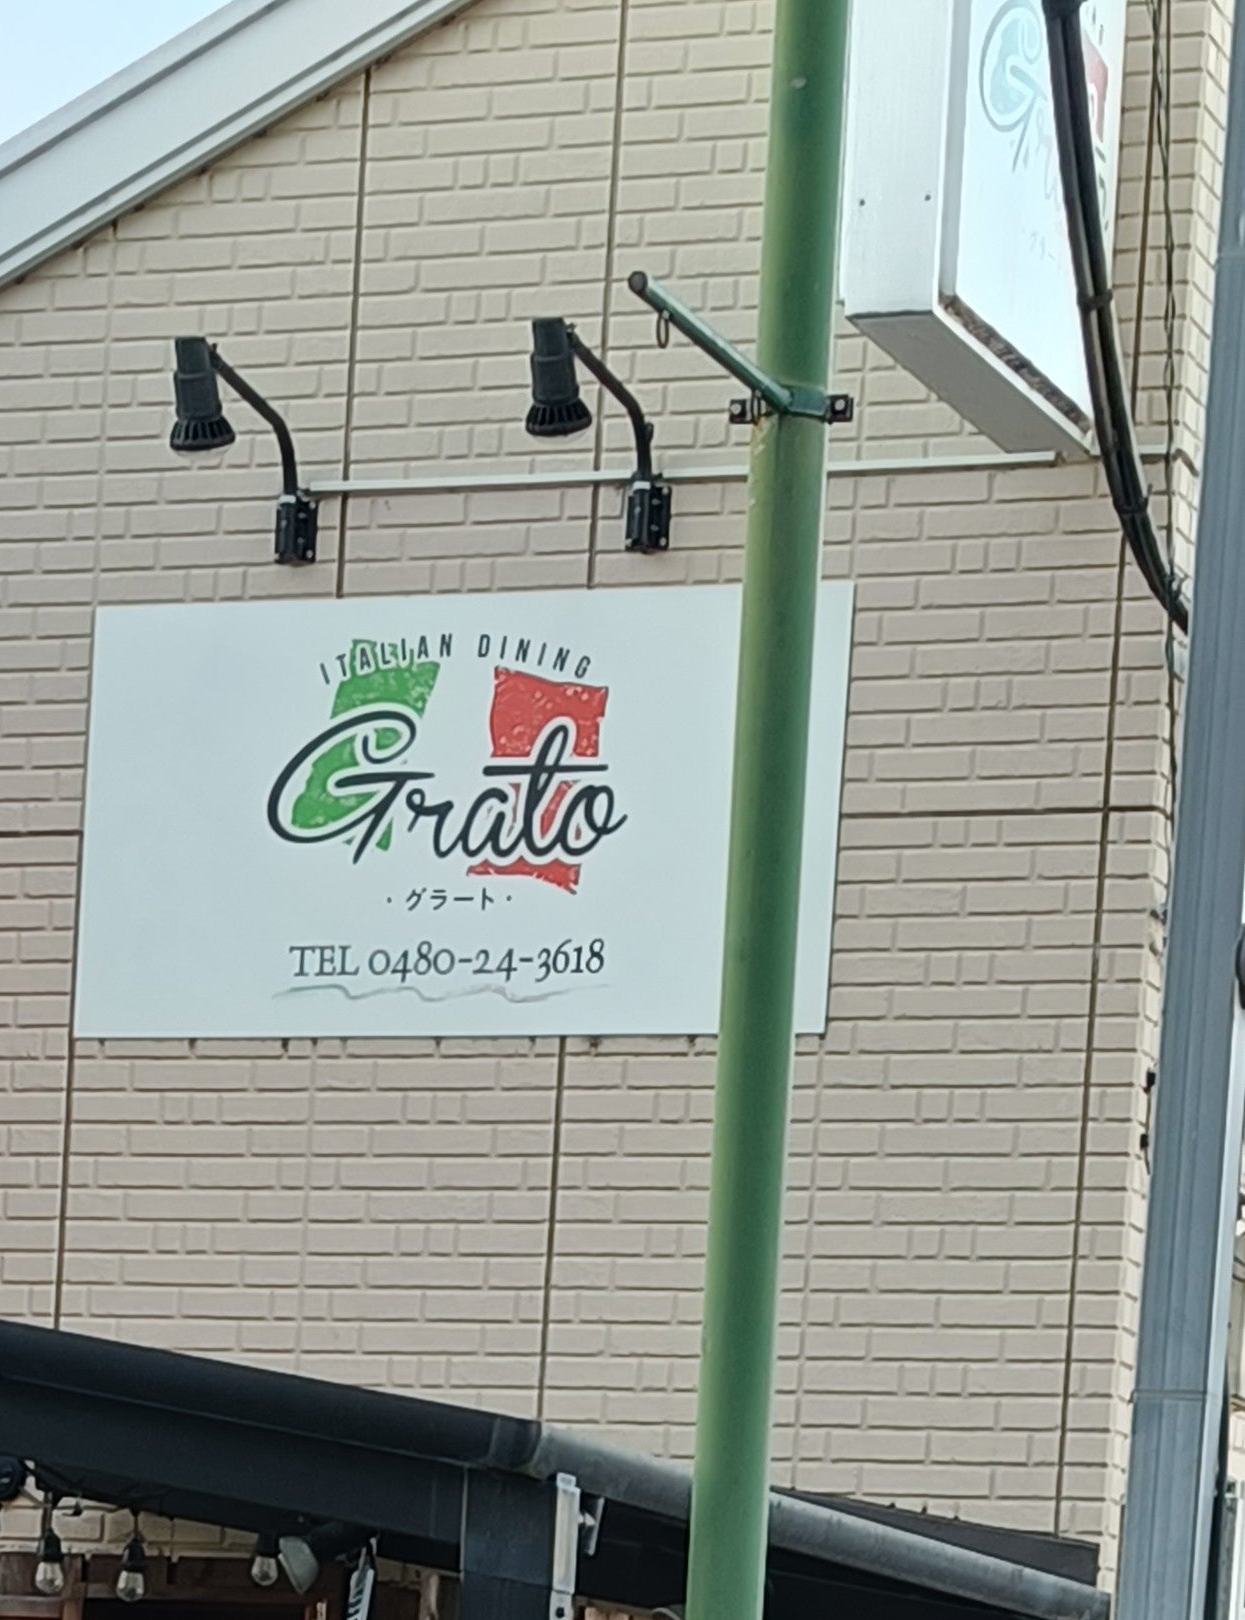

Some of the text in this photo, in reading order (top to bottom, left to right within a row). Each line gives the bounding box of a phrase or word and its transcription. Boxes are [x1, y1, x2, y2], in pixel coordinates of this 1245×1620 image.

[319, 633, 592, 685] ITALIAN DINING
[266, 709, 629, 865] Grato
[288, 937, 606, 983] TEL 0480-24-3618
